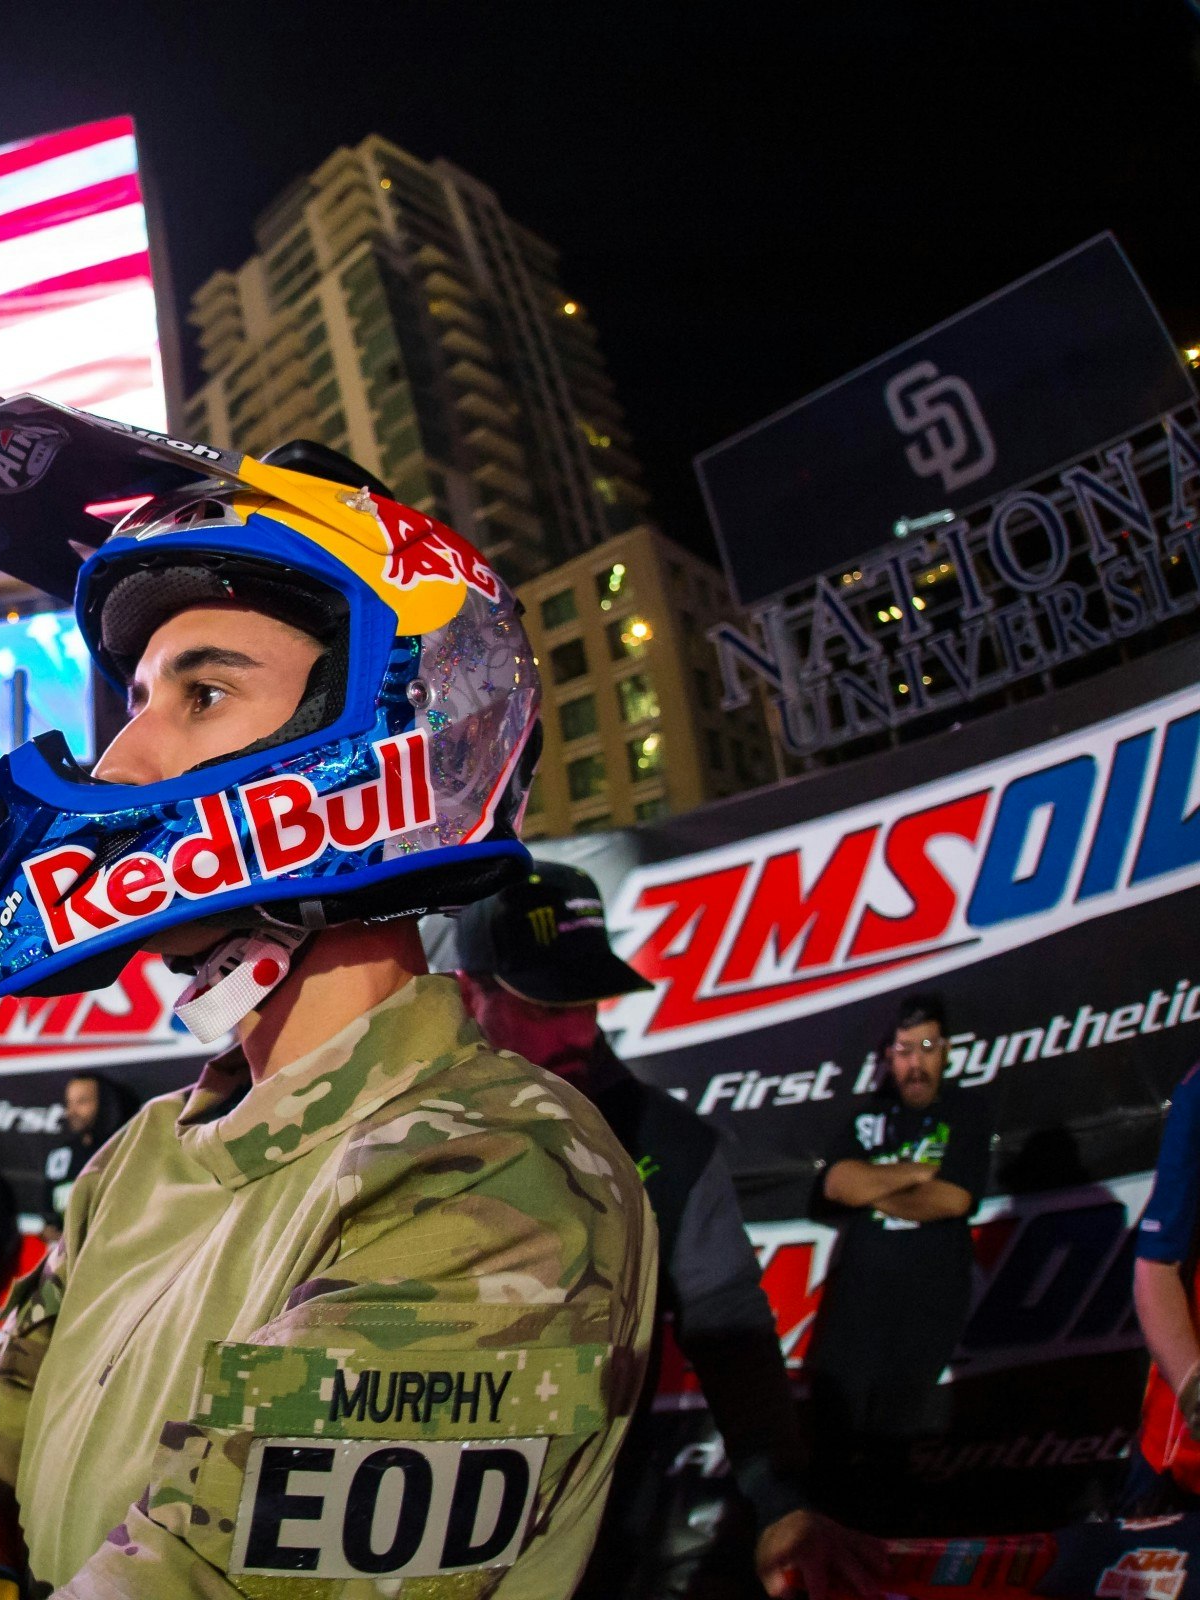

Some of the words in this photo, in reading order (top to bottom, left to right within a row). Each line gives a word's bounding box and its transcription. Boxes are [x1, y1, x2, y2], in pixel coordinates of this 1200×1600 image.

[27, 792, 247, 949] Red
[244, 733, 437, 874] Bull
[696, 1061, 843, 1117] First
[852, 1050, 879, 1095] i
[328, 1368, 513, 1424] MURPHY
[244, 1446, 530, 1575] EOD
